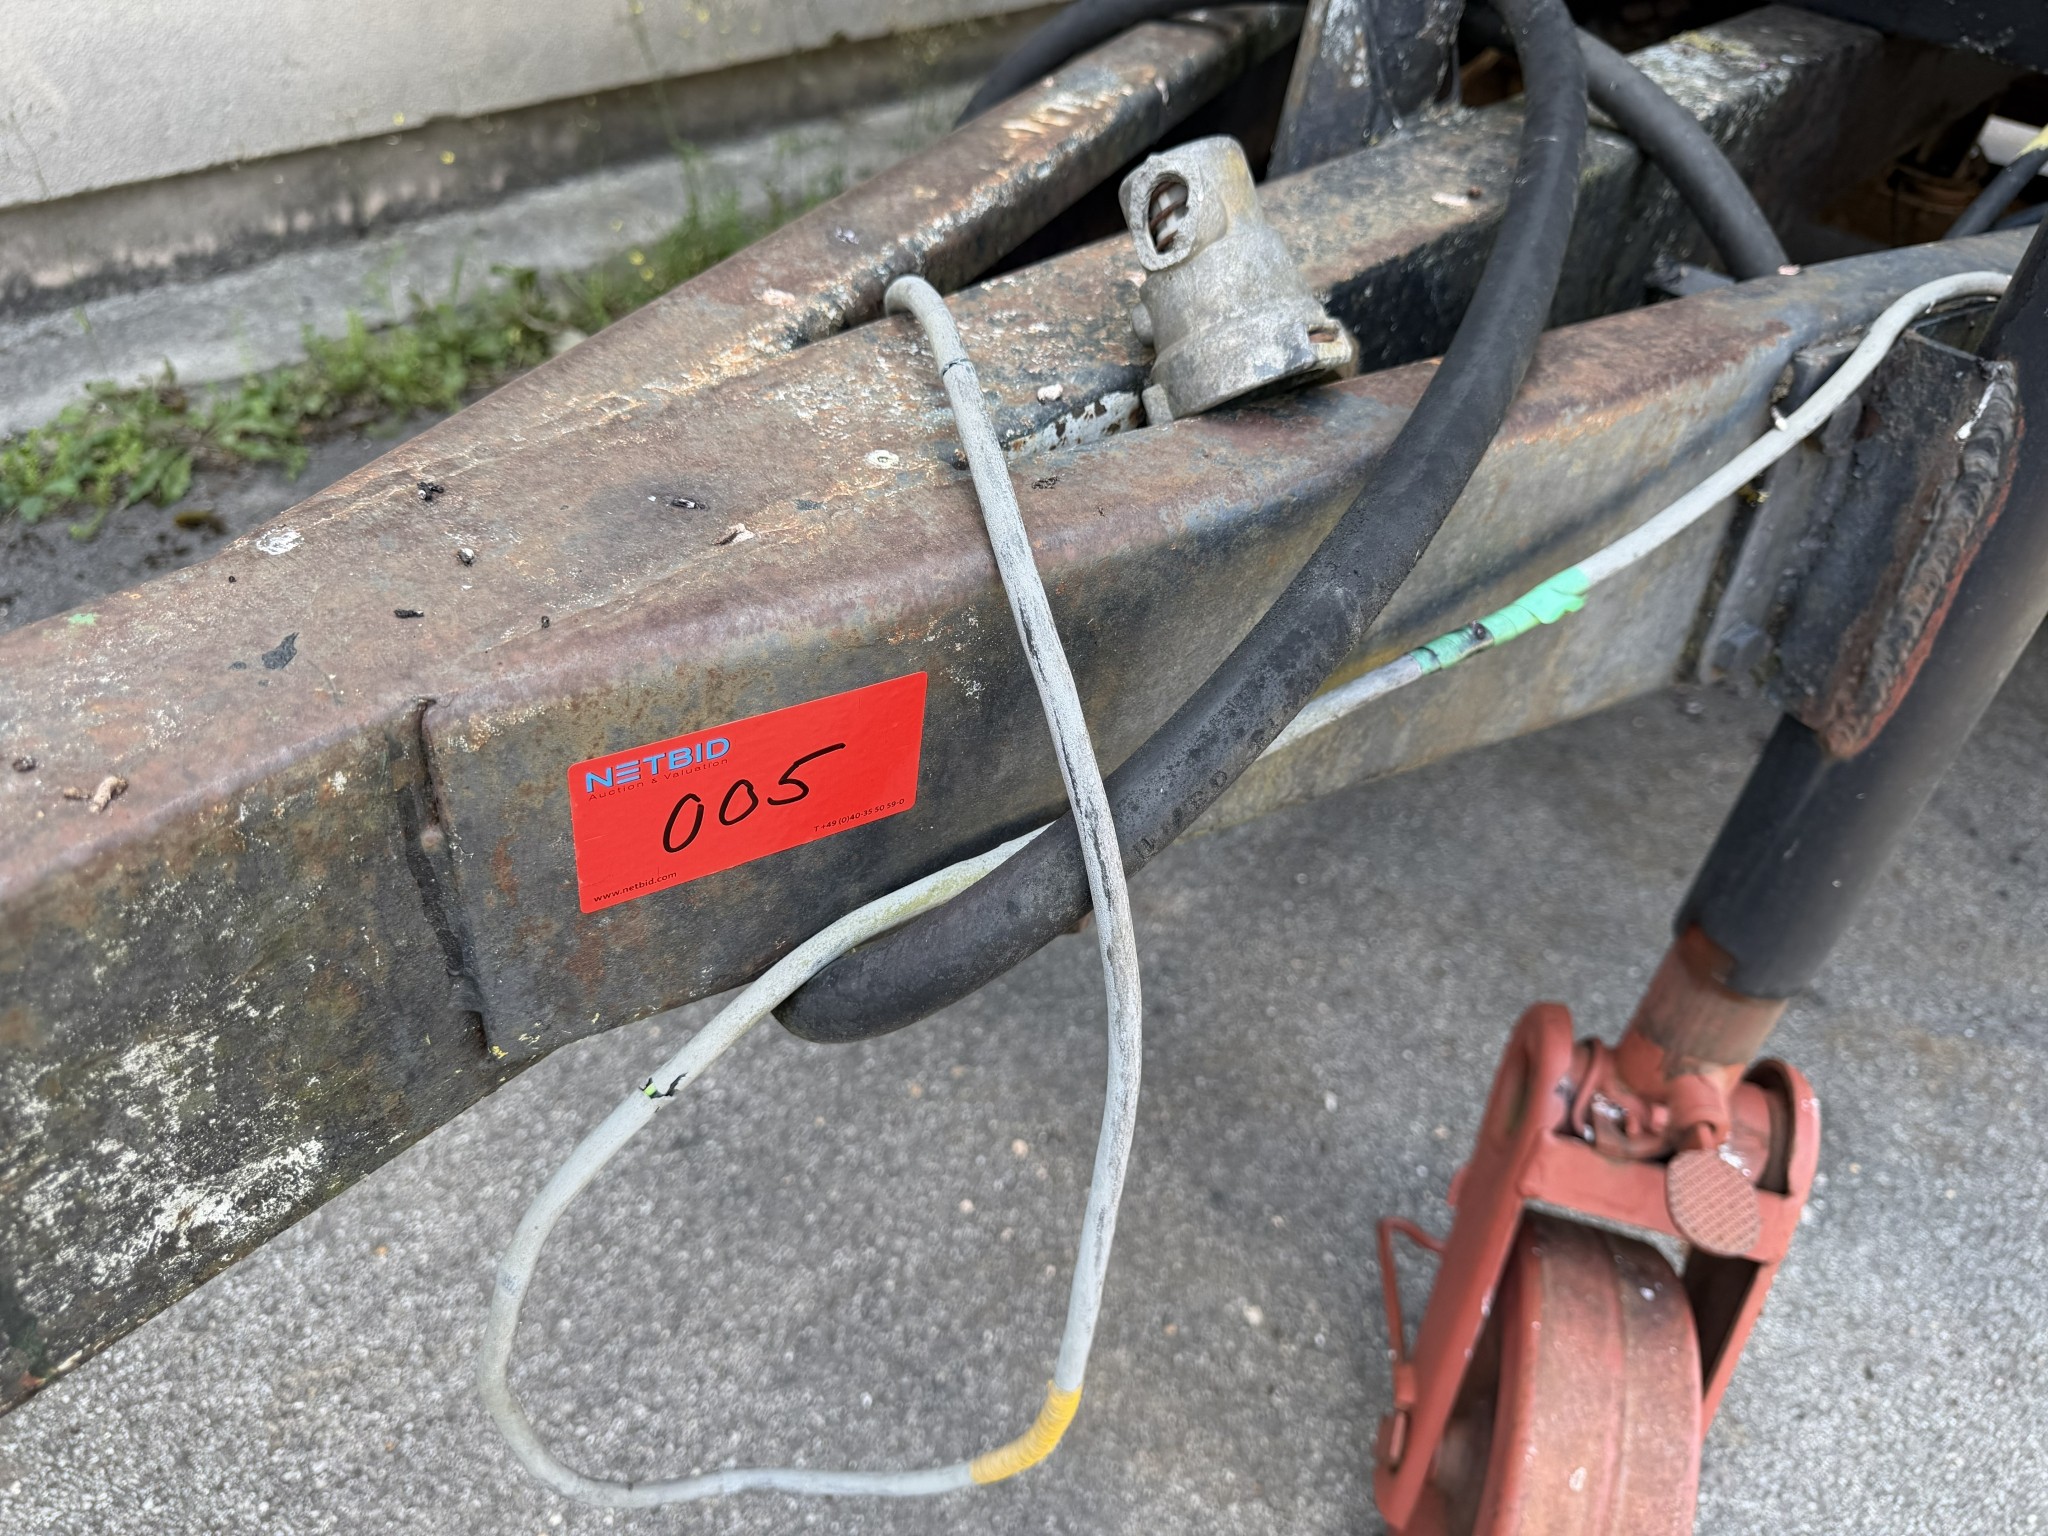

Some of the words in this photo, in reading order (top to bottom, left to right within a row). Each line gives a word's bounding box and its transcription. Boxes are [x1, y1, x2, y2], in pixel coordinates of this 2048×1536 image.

[585, 737, 731, 793] NETBID
[588, 781, 644, 802] Auction
[650, 777, 658, 785] &
[663, 759, 729, 780] Valuation
[662, 743, 846, 854] 005
[820, 819, 837, 830] +49
[838, 808, 873, 826] (0)40-35
[874, 804, 885, 813] 50
[886, 798, 905, 809] 59-0
[593, 871, 677, 902] www.netbid.com
